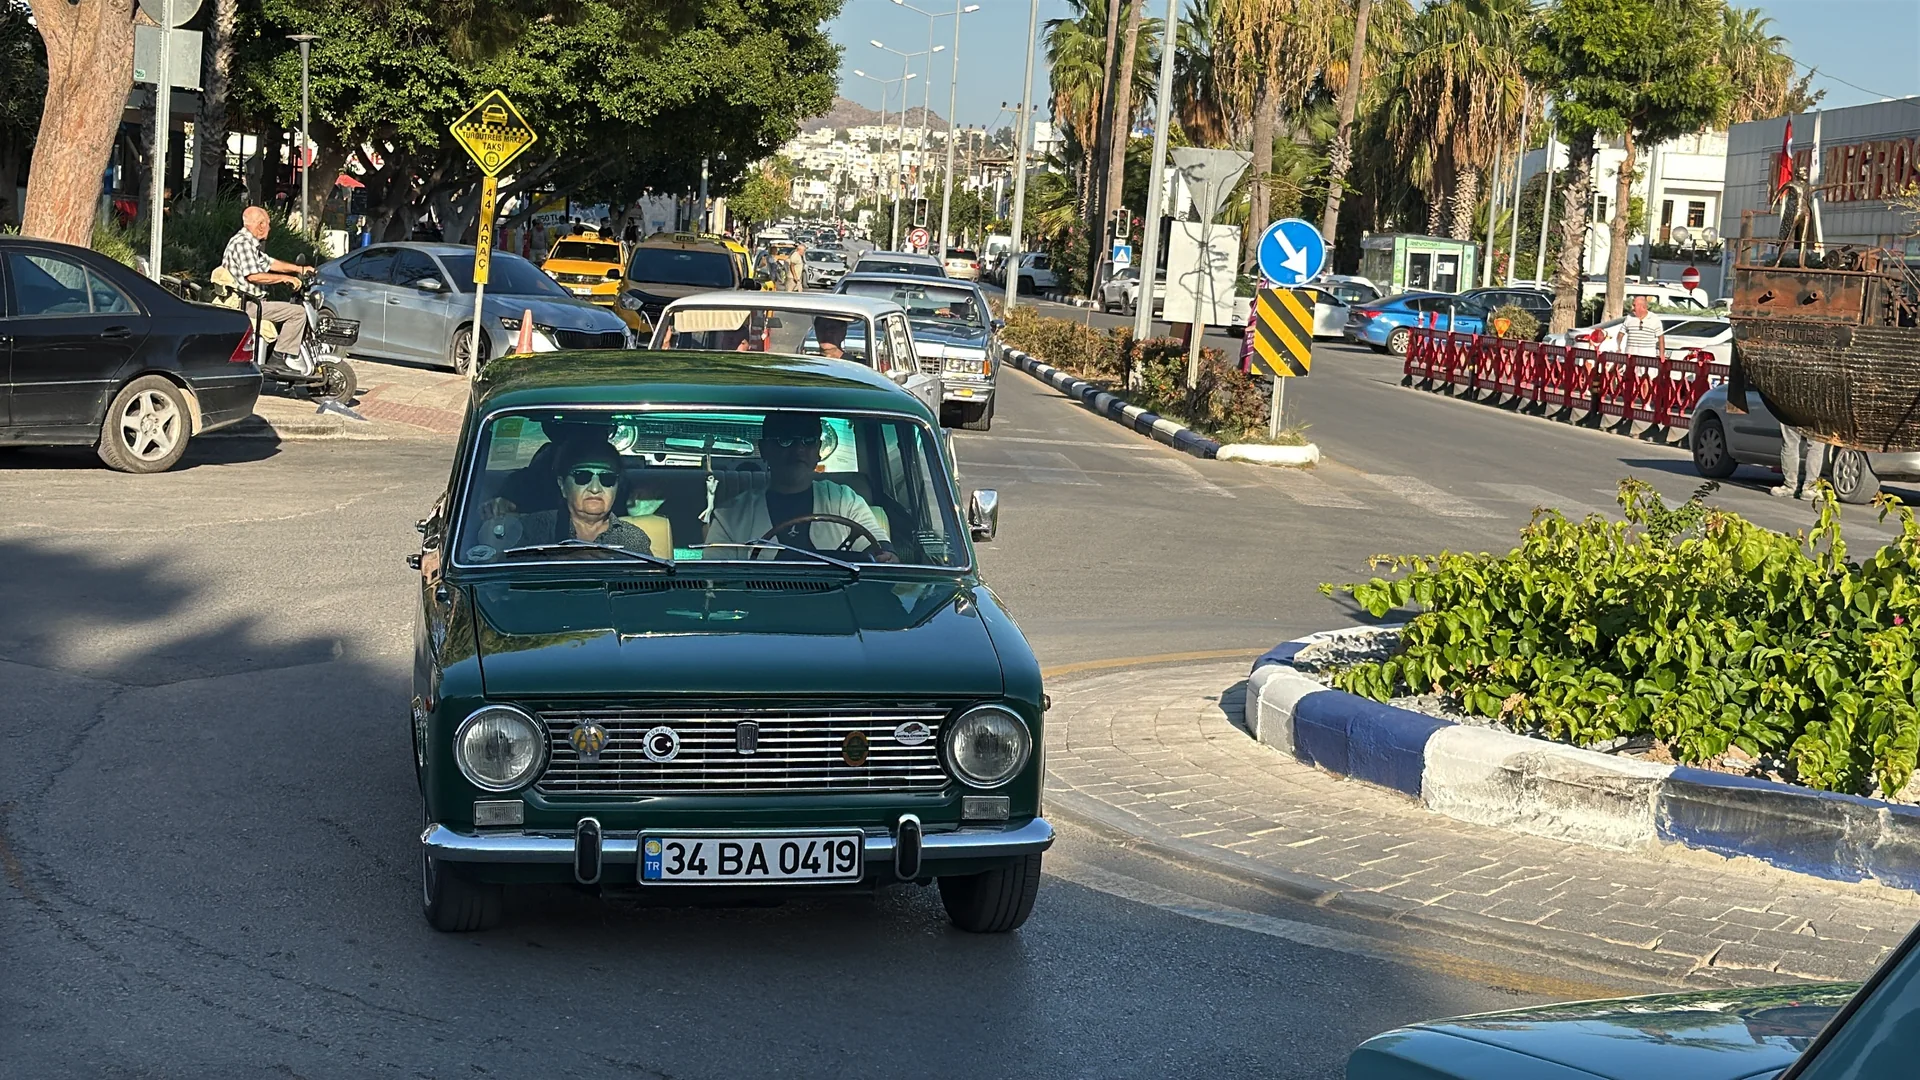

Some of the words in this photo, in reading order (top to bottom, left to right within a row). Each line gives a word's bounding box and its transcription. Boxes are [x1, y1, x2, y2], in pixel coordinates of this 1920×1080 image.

[478, 223, 490, 270] ARAÇ
[646, 861, 660, 871] TR
[665, 841, 708, 875] 34
[718, 842, 769, 875] BA
[779, 840, 856, 875] 0419
